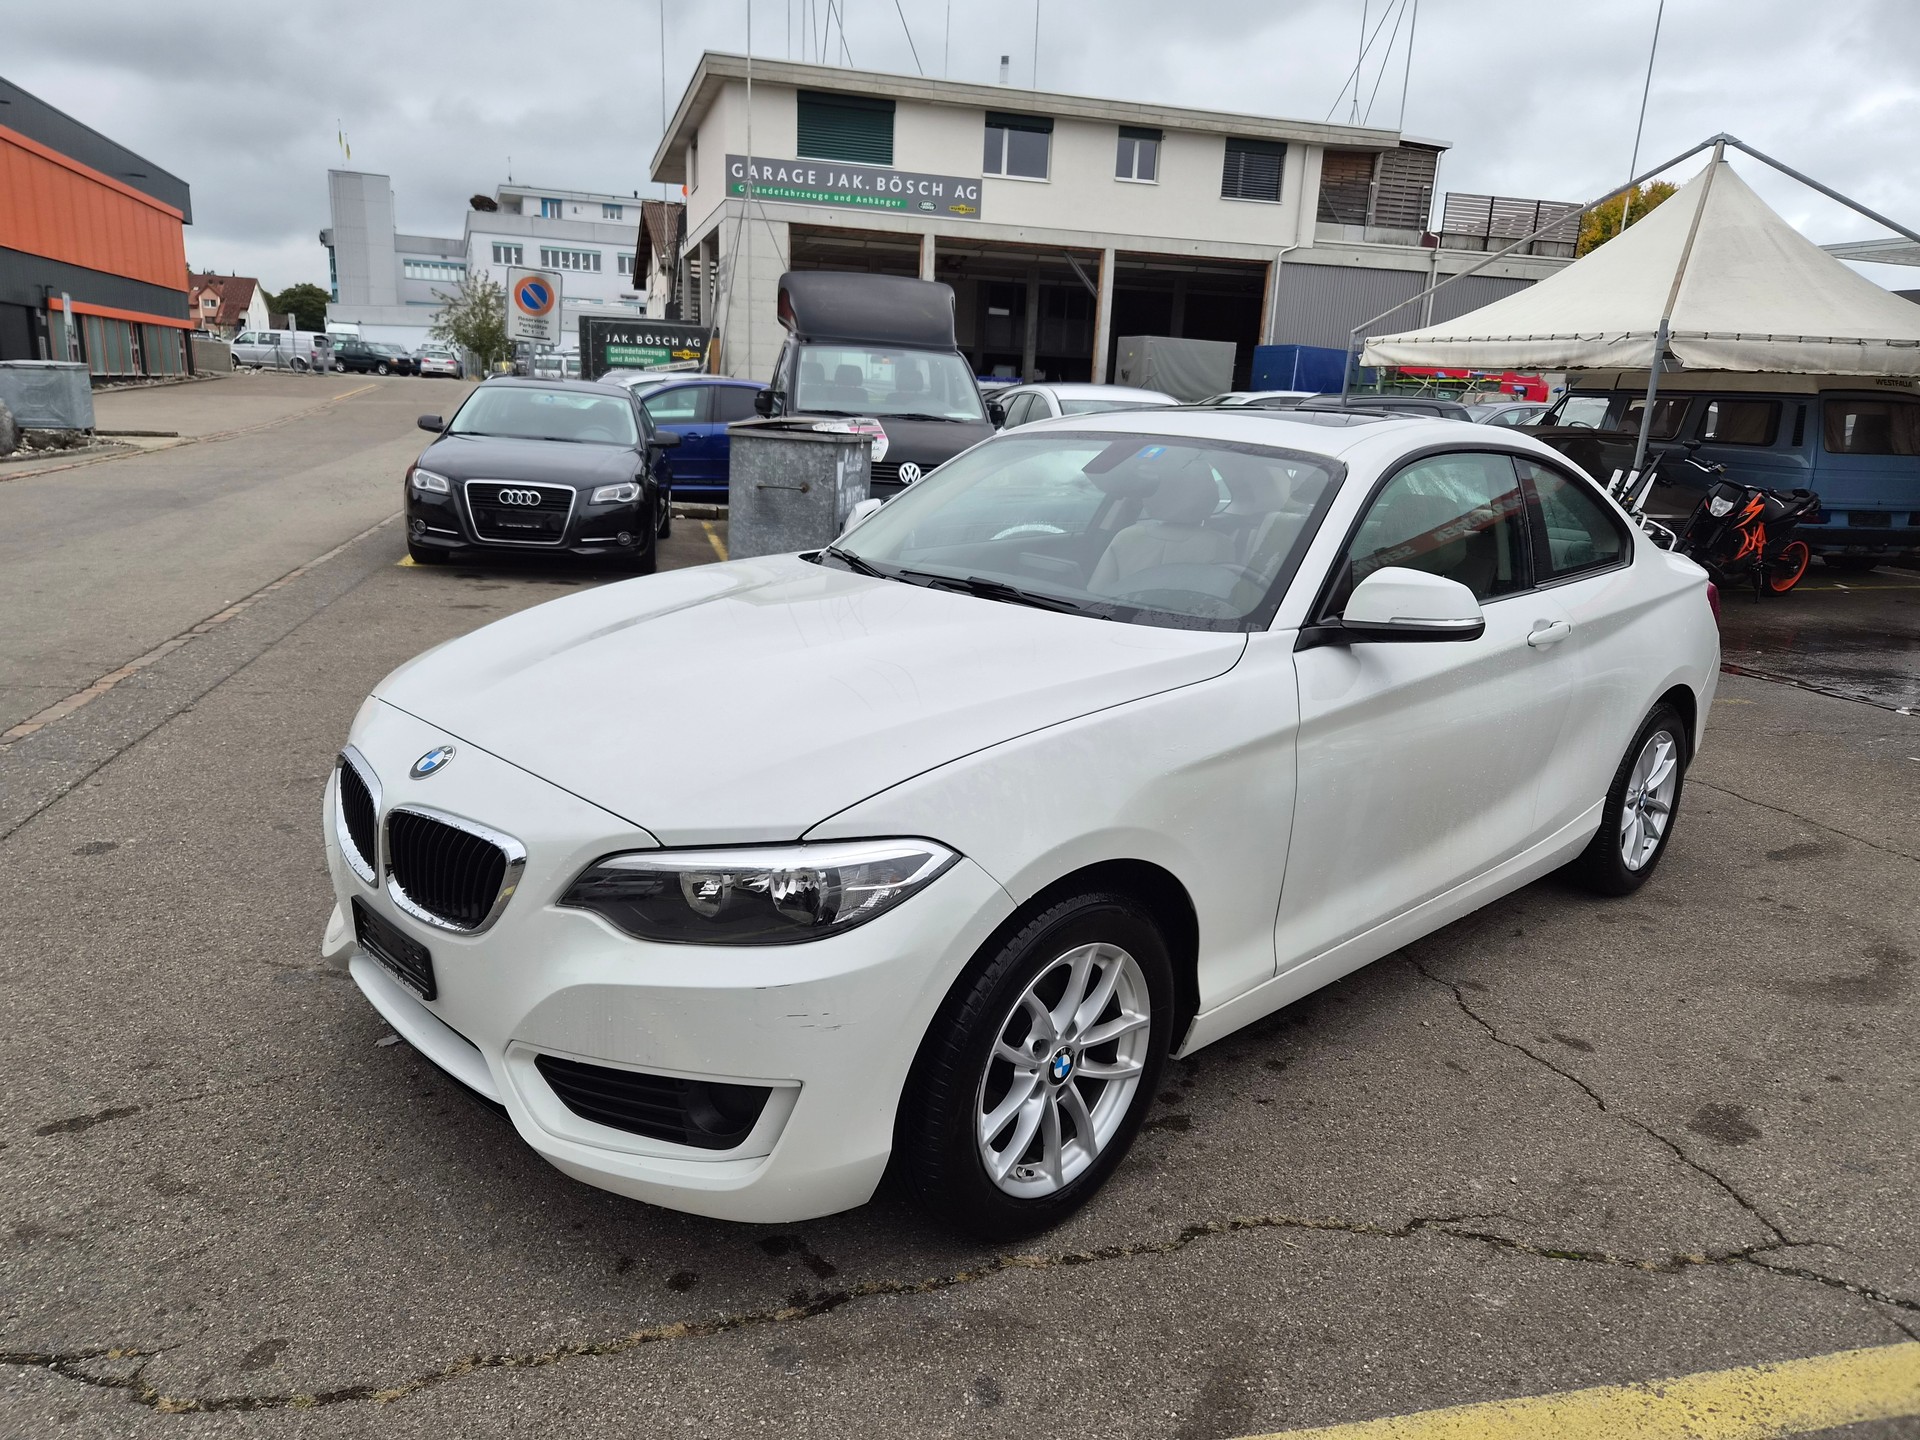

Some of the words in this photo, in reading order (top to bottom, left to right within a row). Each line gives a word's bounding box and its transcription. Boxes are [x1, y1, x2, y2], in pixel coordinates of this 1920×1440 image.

[731, 162, 816, 185] GARAGE
[827, 172, 870, 190] JAK.
[876, 175, 943, 197] BÖSCH
[954, 184, 977, 200] AG
[738, 184, 829, 201] Gändefahrzeuge
[834, 194, 851, 203] und
[856, 196, 901, 208] Anhänger
[606, 334, 633, 344] JAK.
[636, 334, 679, 346] BÖSCH
[686, 338, 701, 348] AG
[610, 347, 667, 357] Geländefahrzeuge
[624, 356, 654, 365] Anhänger
